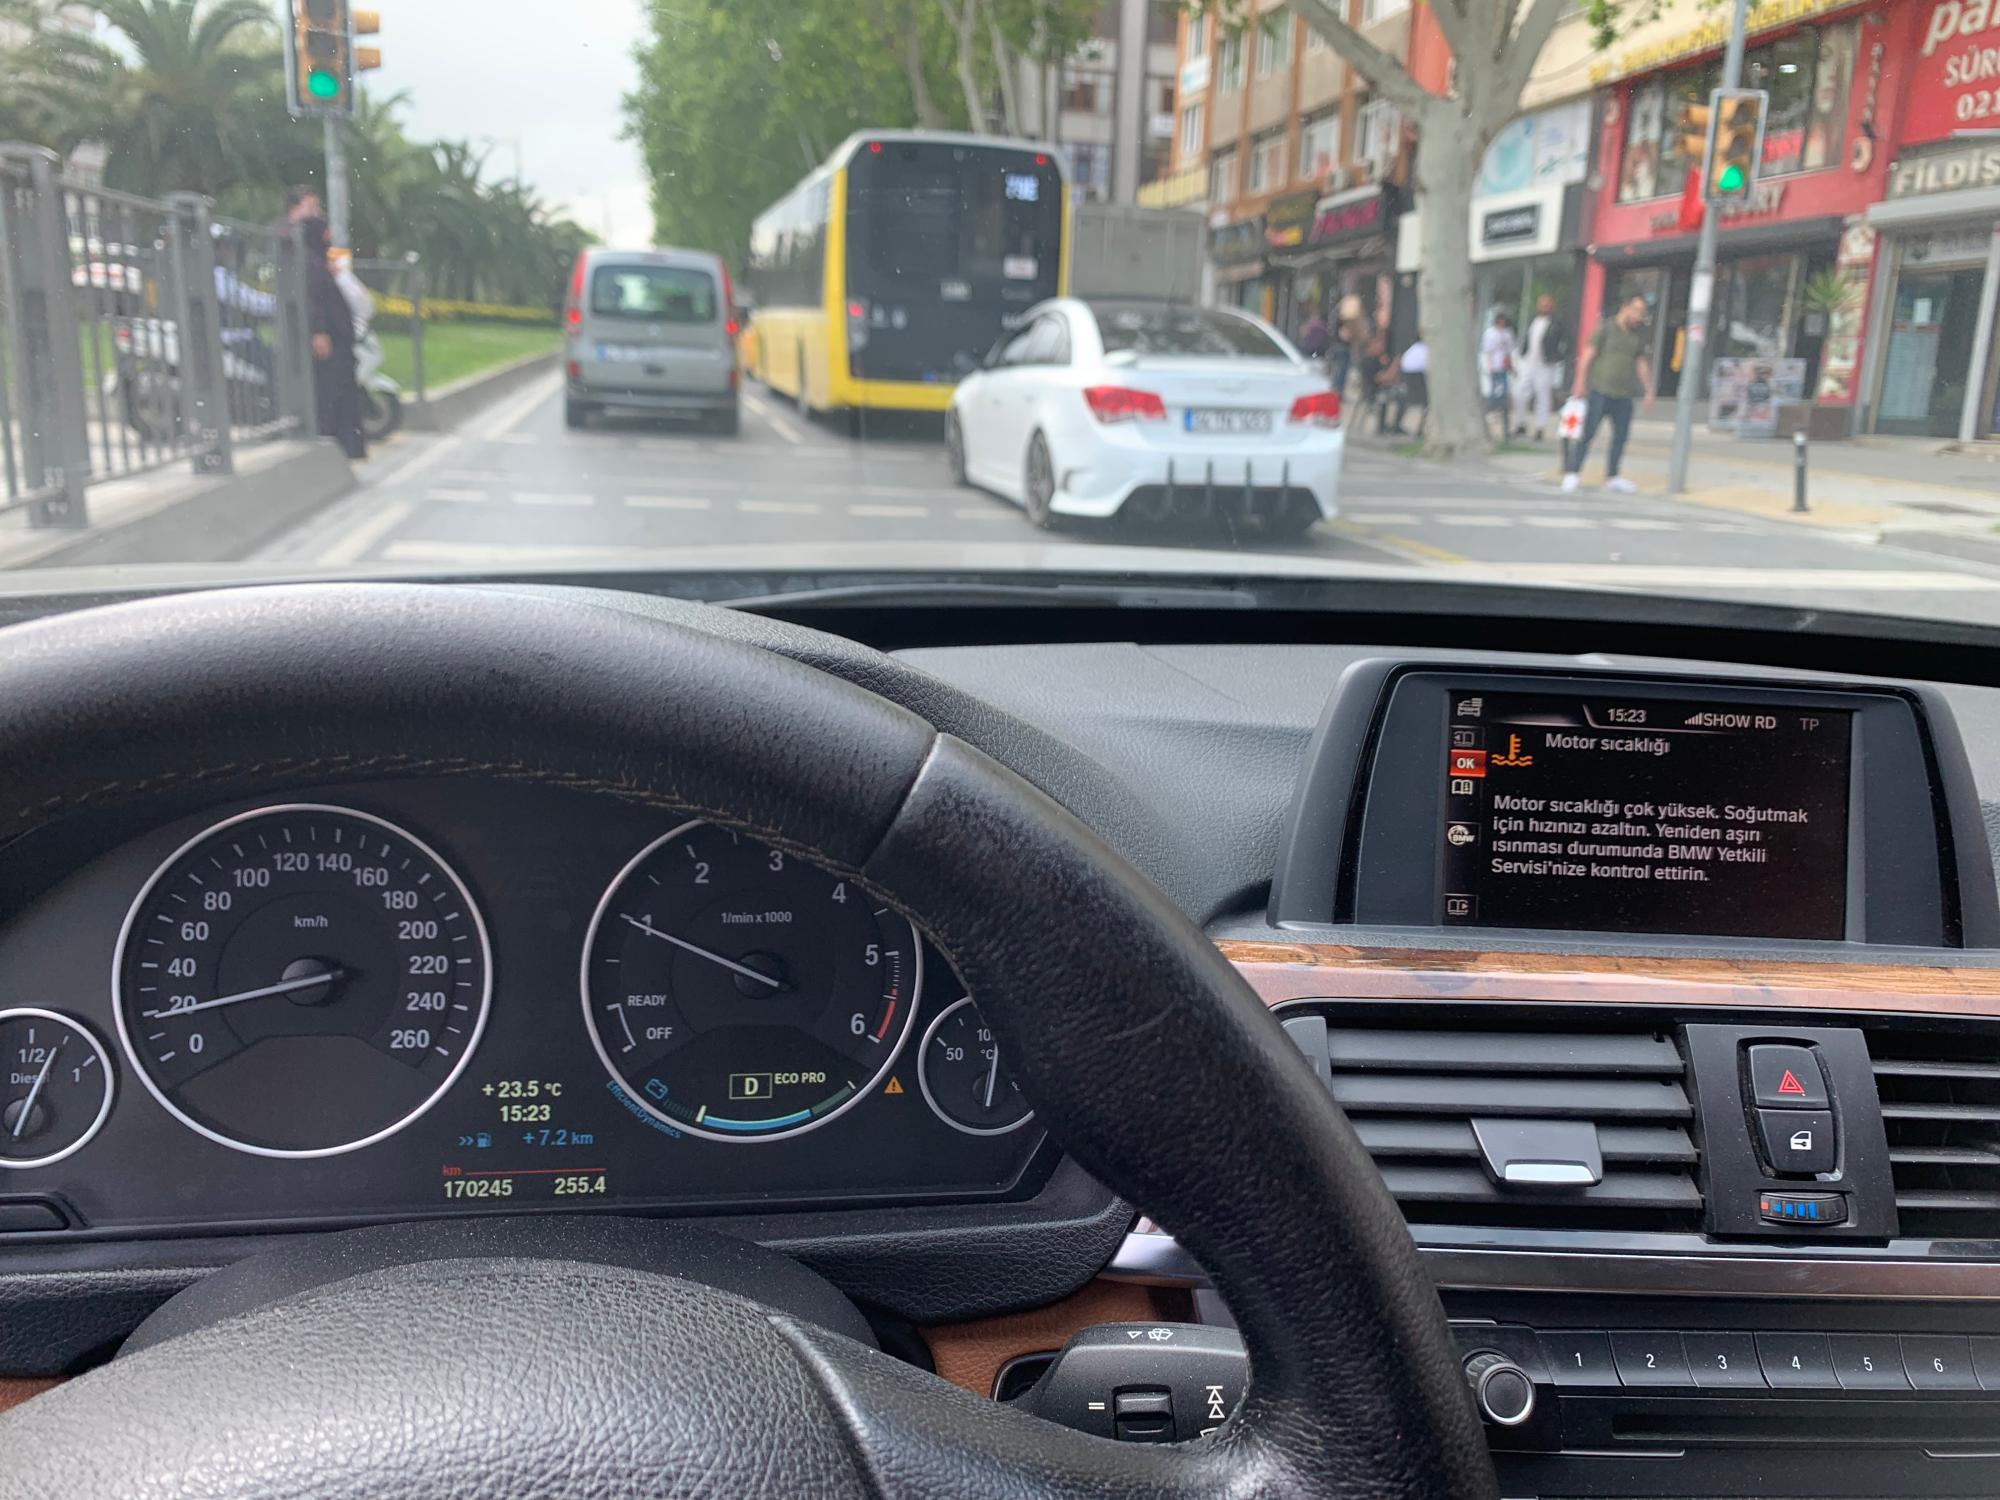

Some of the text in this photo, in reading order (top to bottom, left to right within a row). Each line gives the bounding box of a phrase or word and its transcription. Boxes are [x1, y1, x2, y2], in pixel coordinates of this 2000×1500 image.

[1944, 44, 2000, 88] SÜR
[1607, 708, 1647, 723] 15:23
[1703, 713, 1777, 730] SHOW RD
[1800, 718, 1819, 731] TP
[1545, 733, 1670, 756] Motor sıcaklığı
[1456, 758, 1475, 769] OK
[1494, 795, 1809, 824] Motor sıcaklığı çok yüksek. Soğutmak
[1493, 816, 1760, 845] için hızınızı azaltın. Yeniden aşırı
[769, 850, 783, 871] 3
[1492, 840, 1766, 863] ısınması durumunda BMW Yetkili
[273, 853, 309, 872] 120
[316, 853, 352, 872] 140
[1491, 858, 1709, 882] Servisi'nize kontrol ettirin.
[233, 868, 270, 888] 100
[353, 867, 388, 886] 160
[695, 862, 710, 884] 2
[204, 891, 232, 911] 80
[382, 890, 418, 910] 180
[832, 883, 846, 903] 4
[294, 915, 328, 928] km/h
[641, 914, 652, 936] 1
[721, 911, 792, 924] 1/min x 1000
[181, 922, 209, 941] 60
[398, 921, 437, 940] 200
[409, 955, 448, 974] 220
[865, 944, 879, 966] 5
[168, 958, 196, 977] 40
[169, 995, 197, 1015] 20
[406, 992, 446, 1011] 240
[627, 995, 667, 1007] READY
[851, 1012, 865, 1035] 6
[189, 1033, 203, 1053] 0
[390, 1029, 430, 1049] 260
[646, 1027, 673, 1040] OFF
[18, 1048, 45, 1064] 1/2
[945, 1047, 964, 1061] 50
[72, 1067, 81, 1083] 1
[774, 1072, 826, 1084] ECO PRO
[744, 1077, 758, 1095] D
[499, 1104, 551, 1122] 15:23
[571, 1131, 593, 1146] km
[443, 1165, 462, 1177] km
[443, 1176, 607, 1198] 170245 255.4
[1575, 1352, 1583, 1367] 1
[1646, 1353, 1656, 1368] 2
[1717, 1354, 1728, 1370] 3
[1791, 1355, 1801, 1370] 4
[1863, 1357, 1873, 1372] 5
[1933, 1358, 1944, 1373] 6
